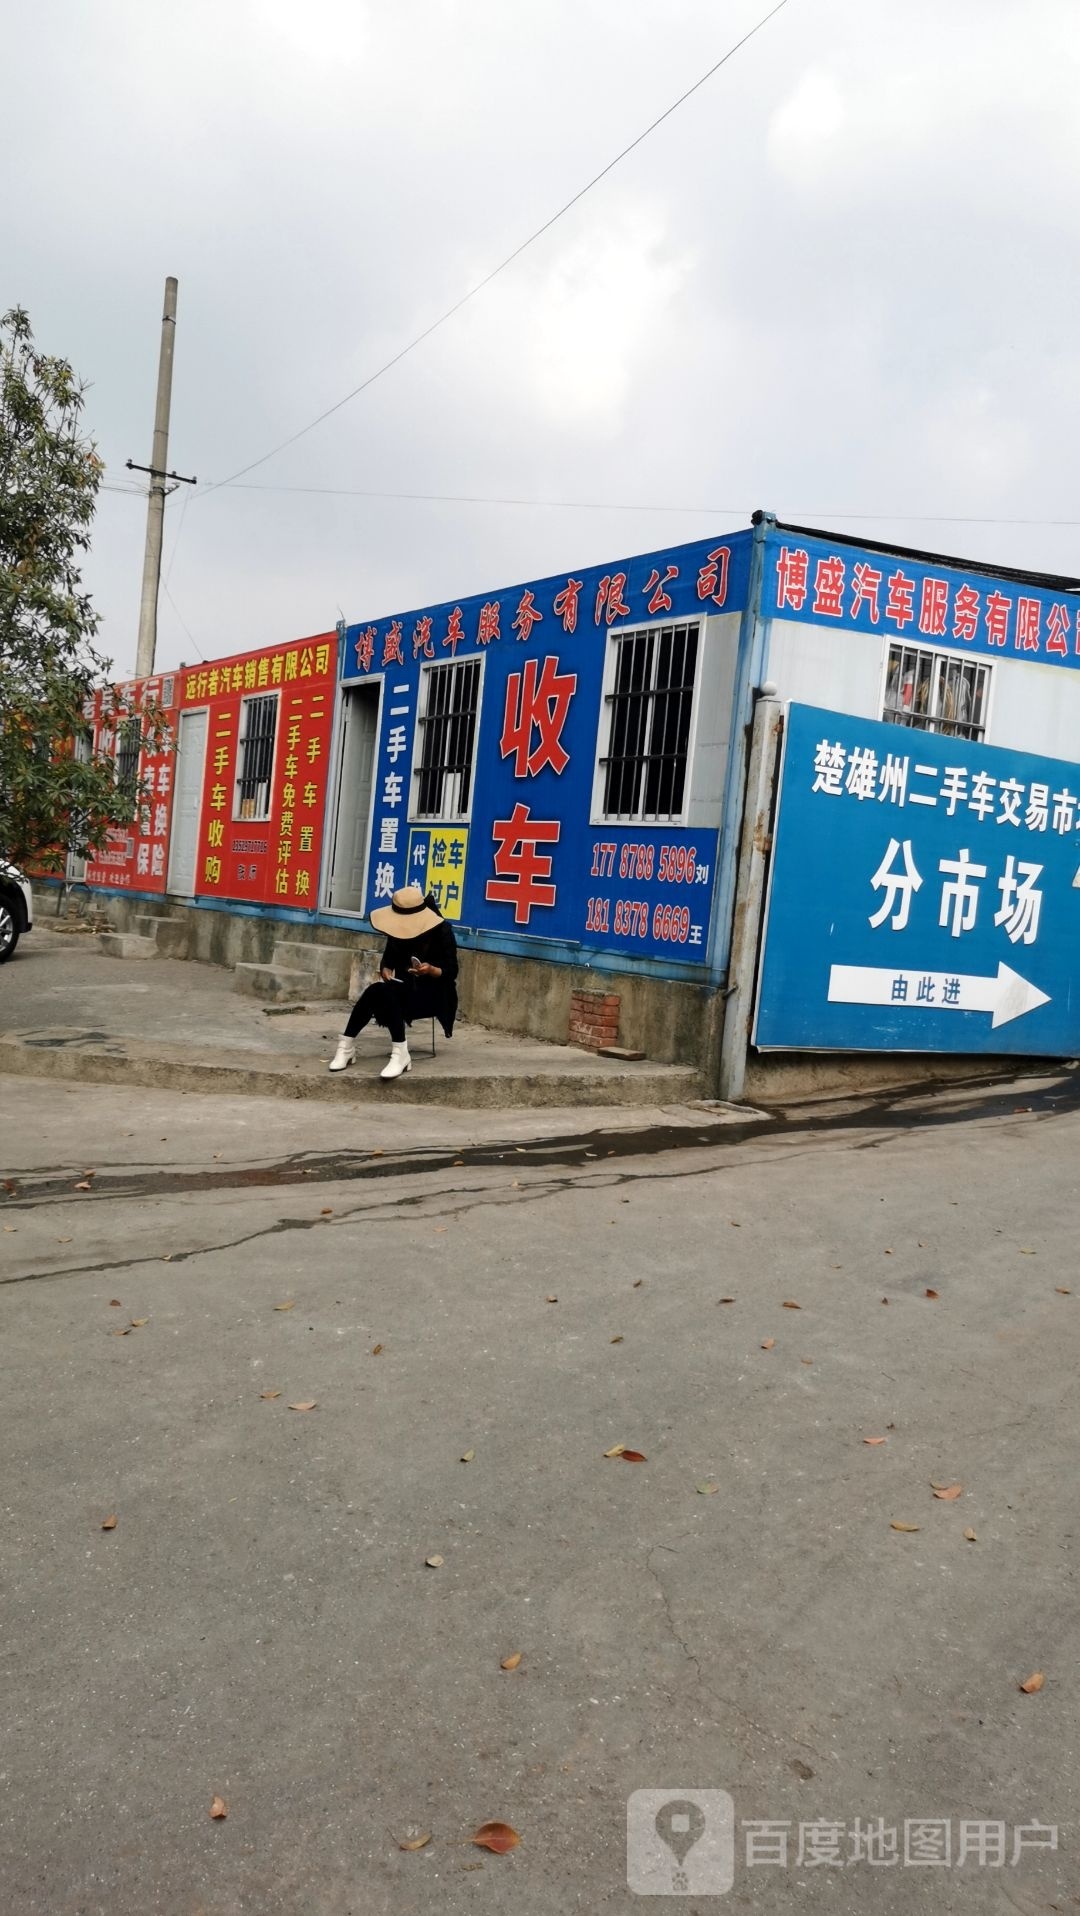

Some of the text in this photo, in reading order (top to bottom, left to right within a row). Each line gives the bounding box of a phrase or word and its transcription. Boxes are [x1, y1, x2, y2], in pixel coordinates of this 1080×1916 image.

[354, 546, 731, 672] 博盛汽车服务有限公司
[776, 547, 1080, 657] 博盛汽车服务有限公
[186, 644, 330, 699] 远行者汽车销售有限公司
[204, 712, 231, 884] 二手车收购
[275, 699, 303, 895] 二手车免费评估
[295, 695, 324, 896] 二手车置换
[374, 684, 409, 898] 二手车置换
[485, 655, 577, 925] 收车
[812, 739, 1080, 836] 楚雄州二手车交易市
[591, 842, 709, 885] 177 8788 5896 刘
[868, 837, 1046, 946] 分市场
[586, 897, 702, 944] 181 8378 6669 王
[890, 974, 962, 1004] 由此进
